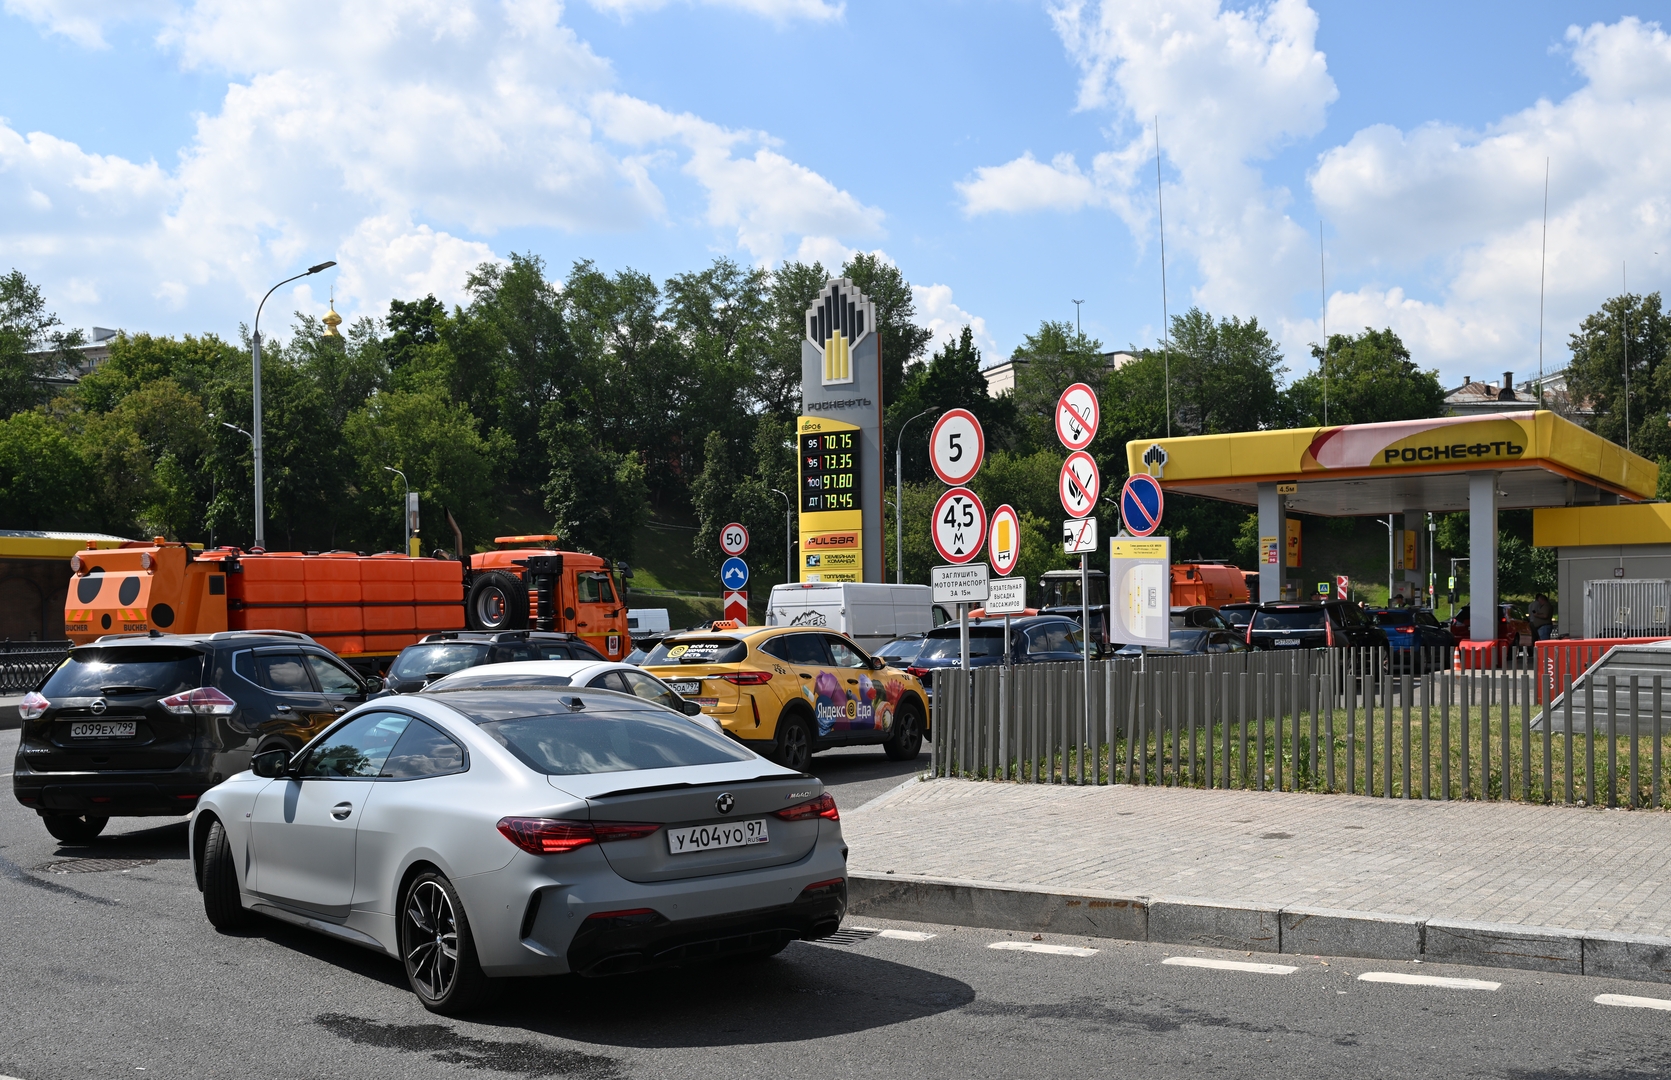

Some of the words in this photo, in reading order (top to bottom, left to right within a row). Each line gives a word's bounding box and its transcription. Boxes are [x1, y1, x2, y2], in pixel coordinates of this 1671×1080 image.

[807, 398, 872, 411] РОСНЕФТЬ
[808, 439, 818, 448] 95
[824, 433, 852, 449] 70.75
[949, 433, 963, 463] 5
[1384, 441, 1523, 463] РОСНЕФТЬ
[808, 458, 818, 468] 95
[824, 453, 852, 469] 73.35
[808, 478, 820, 487] 100
[823, 473, 853, 489] 97.80
[809, 497, 818, 506] ДТ
[825, 493, 853, 508] 79.45
[943, 504, 974, 531] 4,5
[726, 533, 742, 546] 50
[942, 571, 978, 579] ЗАГЛУШИТЬ
[934, 579, 986, 589] МОТОТРАНСПОРТ
[990, 583, 1022, 591] БЯЗАТЕЛЬНАЯ
[994, 592, 1015, 600] ВЫСАДКА
[990, 600, 1020, 608] ПАССАЖИРОВ
[817, 702, 846, 720] Яндекс
[857, 702, 872, 719] Еда
[74, 724, 115, 735] С099ЕХ
[117, 722, 133, 732] 799
[676, 827, 744, 850] У404УО
[747, 821, 763, 837] 97
